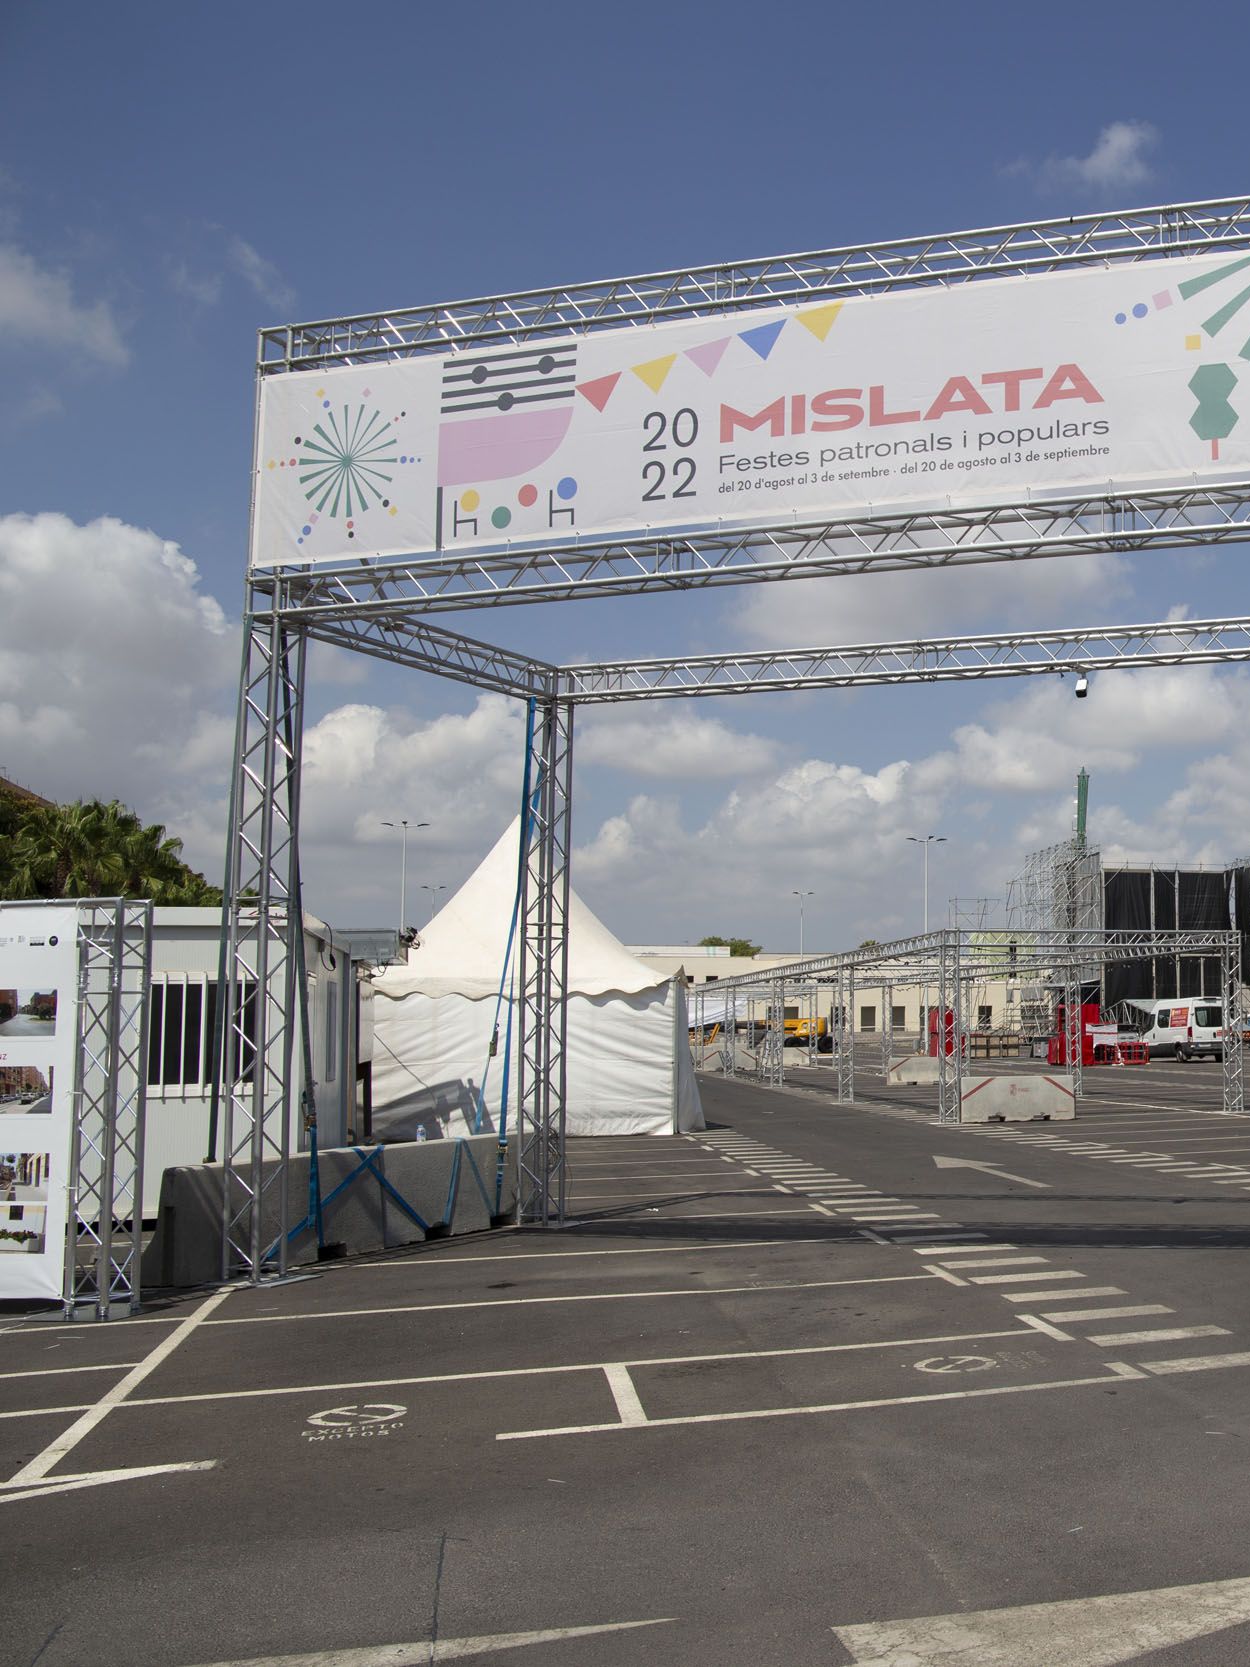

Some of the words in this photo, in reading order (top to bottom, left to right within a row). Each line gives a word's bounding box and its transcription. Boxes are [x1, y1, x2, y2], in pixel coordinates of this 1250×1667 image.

[719, 363, 1105, 444] MISLATA
[642, 407, 699, 452] 20
[719, 450, 810, 474] Festes
[820, 432, 953, 467] patronals
[962, 430, 968, 448] i
[978, 419, 1110, 451] populars
[641, 456, 697, 502] 22
[718, 481, 734, 494] del
[738, 480, 751, 492] 20
[754, 476, 795, 490] d'agost
[798, 473, 808, 485] al
[810, 473, 818, 484] 3
[820, 470, 834, 482] de
[838, 467, 890, 481] setembre
[900, 460, 918, 474] del
[921, 460, 936, 472] 20
[940, 458, 954, 471] de
[957, 456, 997, 471] agosto
[1000, 452, 1010, 465] al
[1014, 452, 1022, 463] 3
[1025, 450, 1040, 462] de
[1044, 444, 1110, 462] septiembre
[301, 1422, 404, 1436] EXCEPTO
[308, 1430, 390, 1442] MOTOS
